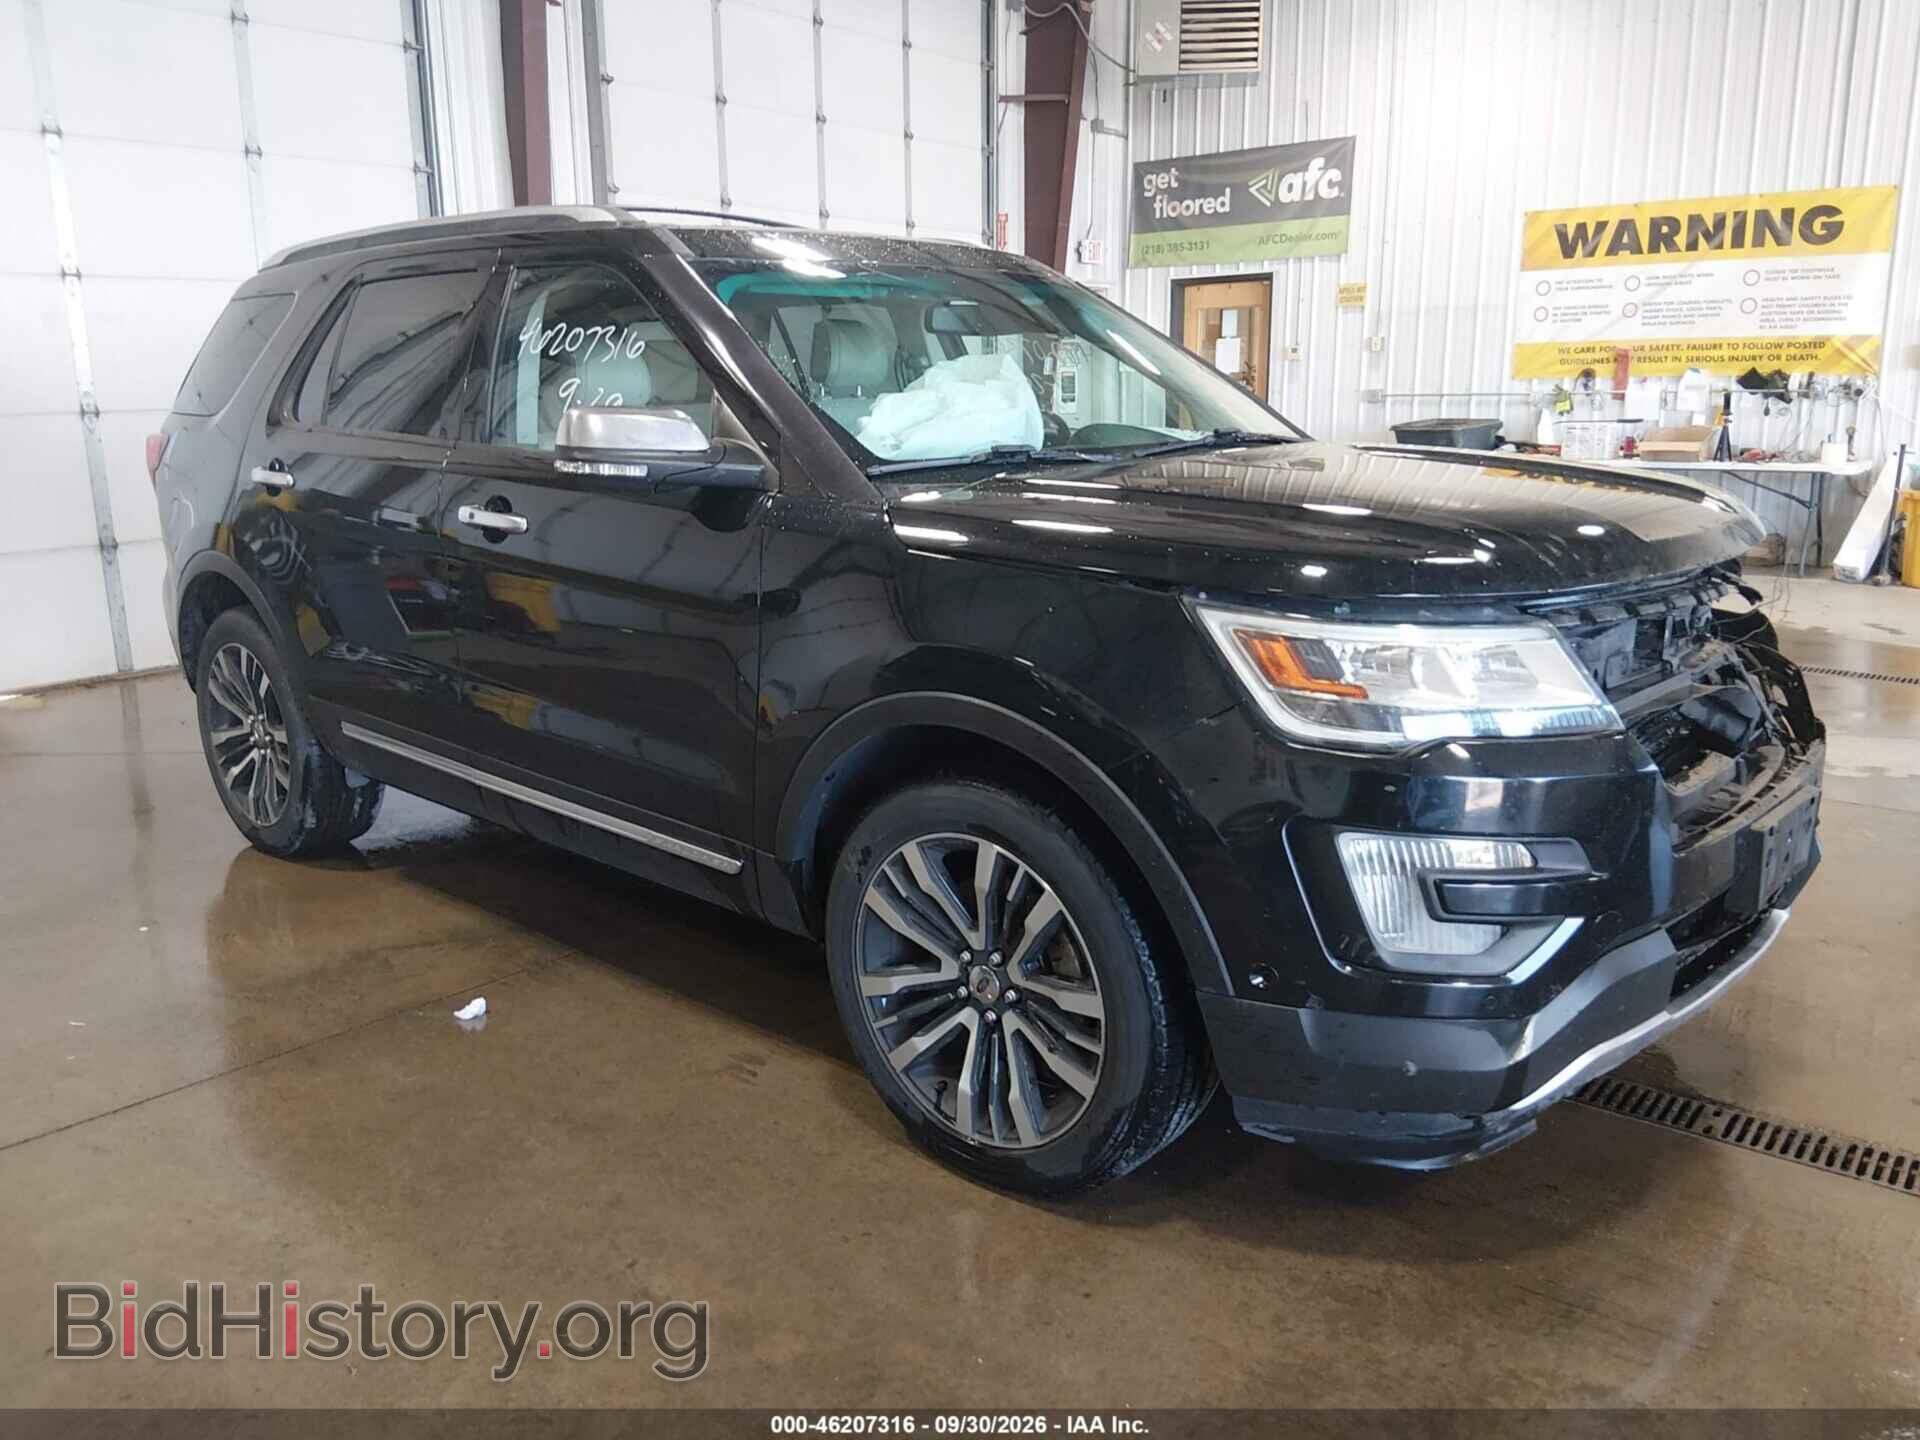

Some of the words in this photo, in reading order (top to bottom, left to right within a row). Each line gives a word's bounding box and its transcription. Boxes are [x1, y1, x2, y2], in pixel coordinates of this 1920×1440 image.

[1143, 167, 1179, 198] get
[1278, 157, 1342, 204] afc
[1153, 187, 1231, 220] floored
[1554, 204, 1845, 259] WARNING
[1558, 346, 1572, 354] WE
[1573, 346, 1596, 354] CARE
[1632, 345, 1646, 353] UR
[1649, 344, 1684, 352] SAFETY.
[1687, 343, 1723, 351] FAILURE
[1743, 342, 1784, 350] FOLLOW
[1787, 341, 1826, 350] POSTED
[1559, 357, 1610, 366] GUIDELINES
[1637, 355, 1669, 363] RESULT
[1686, 354, 1725, 363] SERIOUS
[1728, 353, 1763, 361] INJURY
[1767, 353, 1782, 361] OR
[1786, 352, 1822, 361] DEATH.
